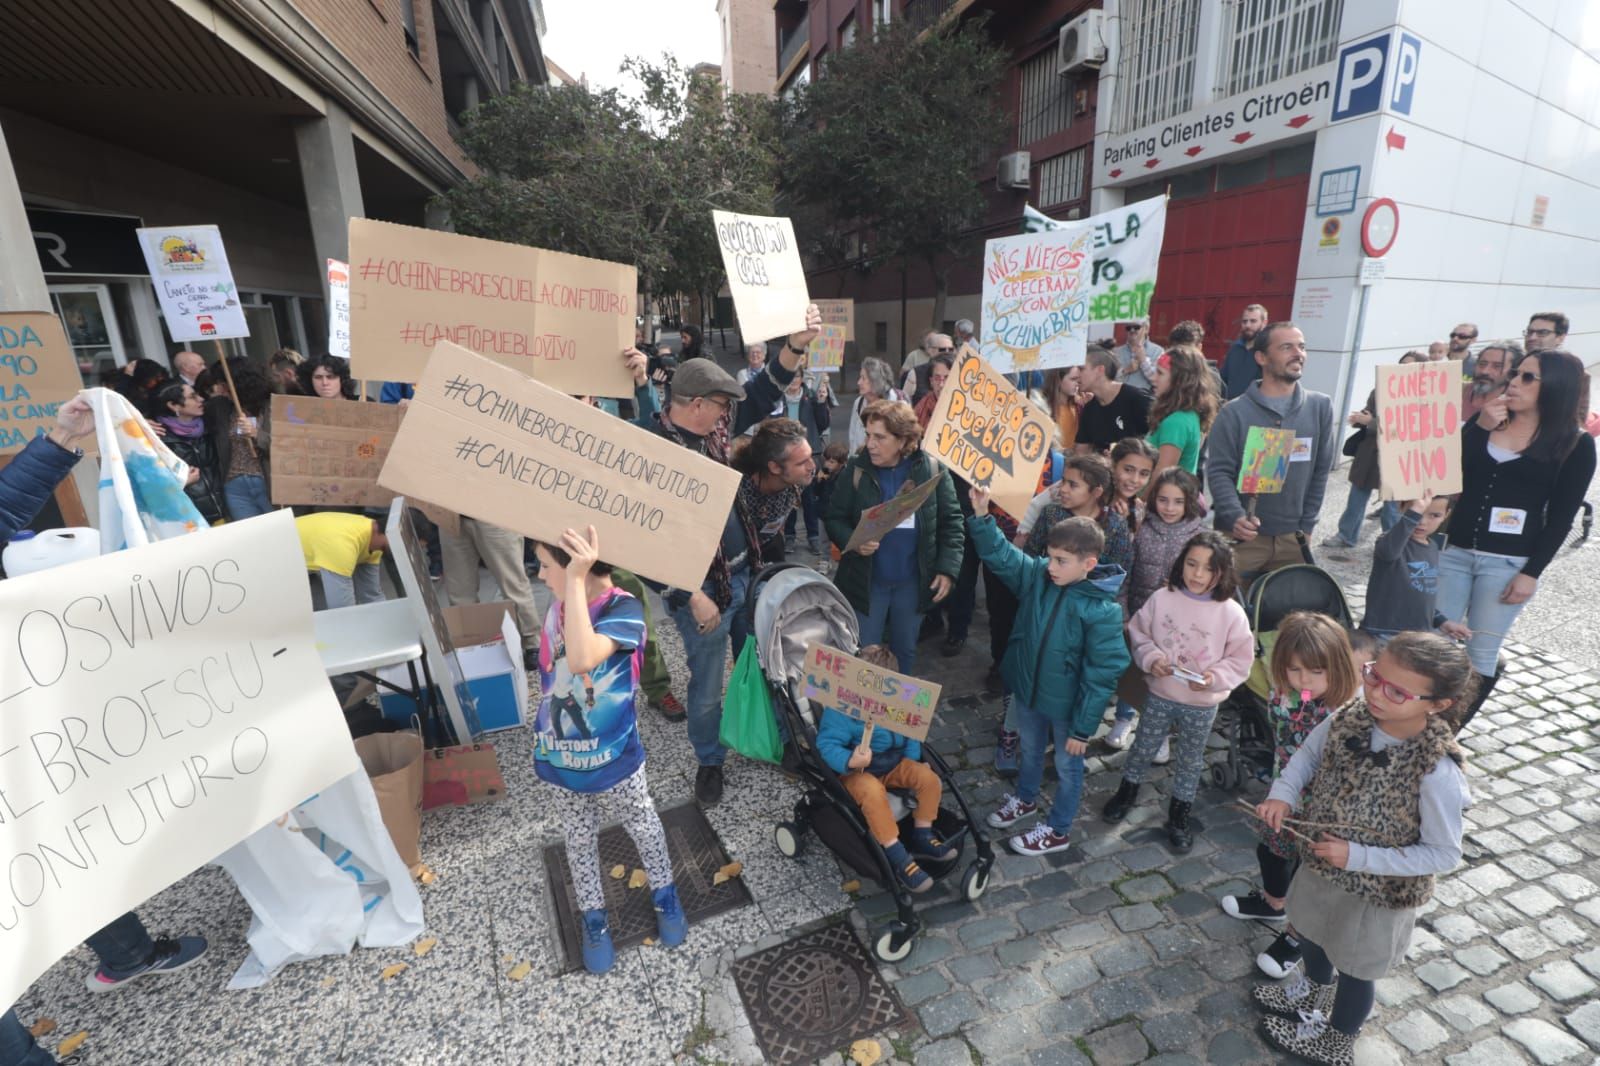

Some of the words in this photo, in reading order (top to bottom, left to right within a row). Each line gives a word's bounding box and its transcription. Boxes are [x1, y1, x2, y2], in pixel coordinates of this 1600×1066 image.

[1337, 47, 1384, 112] P
[1393, 39, 1418, 103] P
[1104, 134, 1156, 166] Parking
[1160, 109, 1235, 147] Clientes
[1242, 78, 1331, 123] Citroën
[359, 257, 629, 316] #OCHINEBROESCUELACONFUTURO
[1022, 296, 1051, 314] CON
[946, 389, 1016, 459] Pueblo
[959, 355, 1026, 432] Caneto
[1384, 401, 1458, 444] PUEBLO
[443, 374, 709, 505] #OCHINEBROESCUELACONFUTURO
[938, 423, 995, 481] Vivo
[1398, 446, 1448, 486] VIVO
[455, 435, 665, 532] #CANETOPUEBLOVIVO
[545, 734, 600, 753] VICTORY
[560, 750, 613, 769] ROYALE
